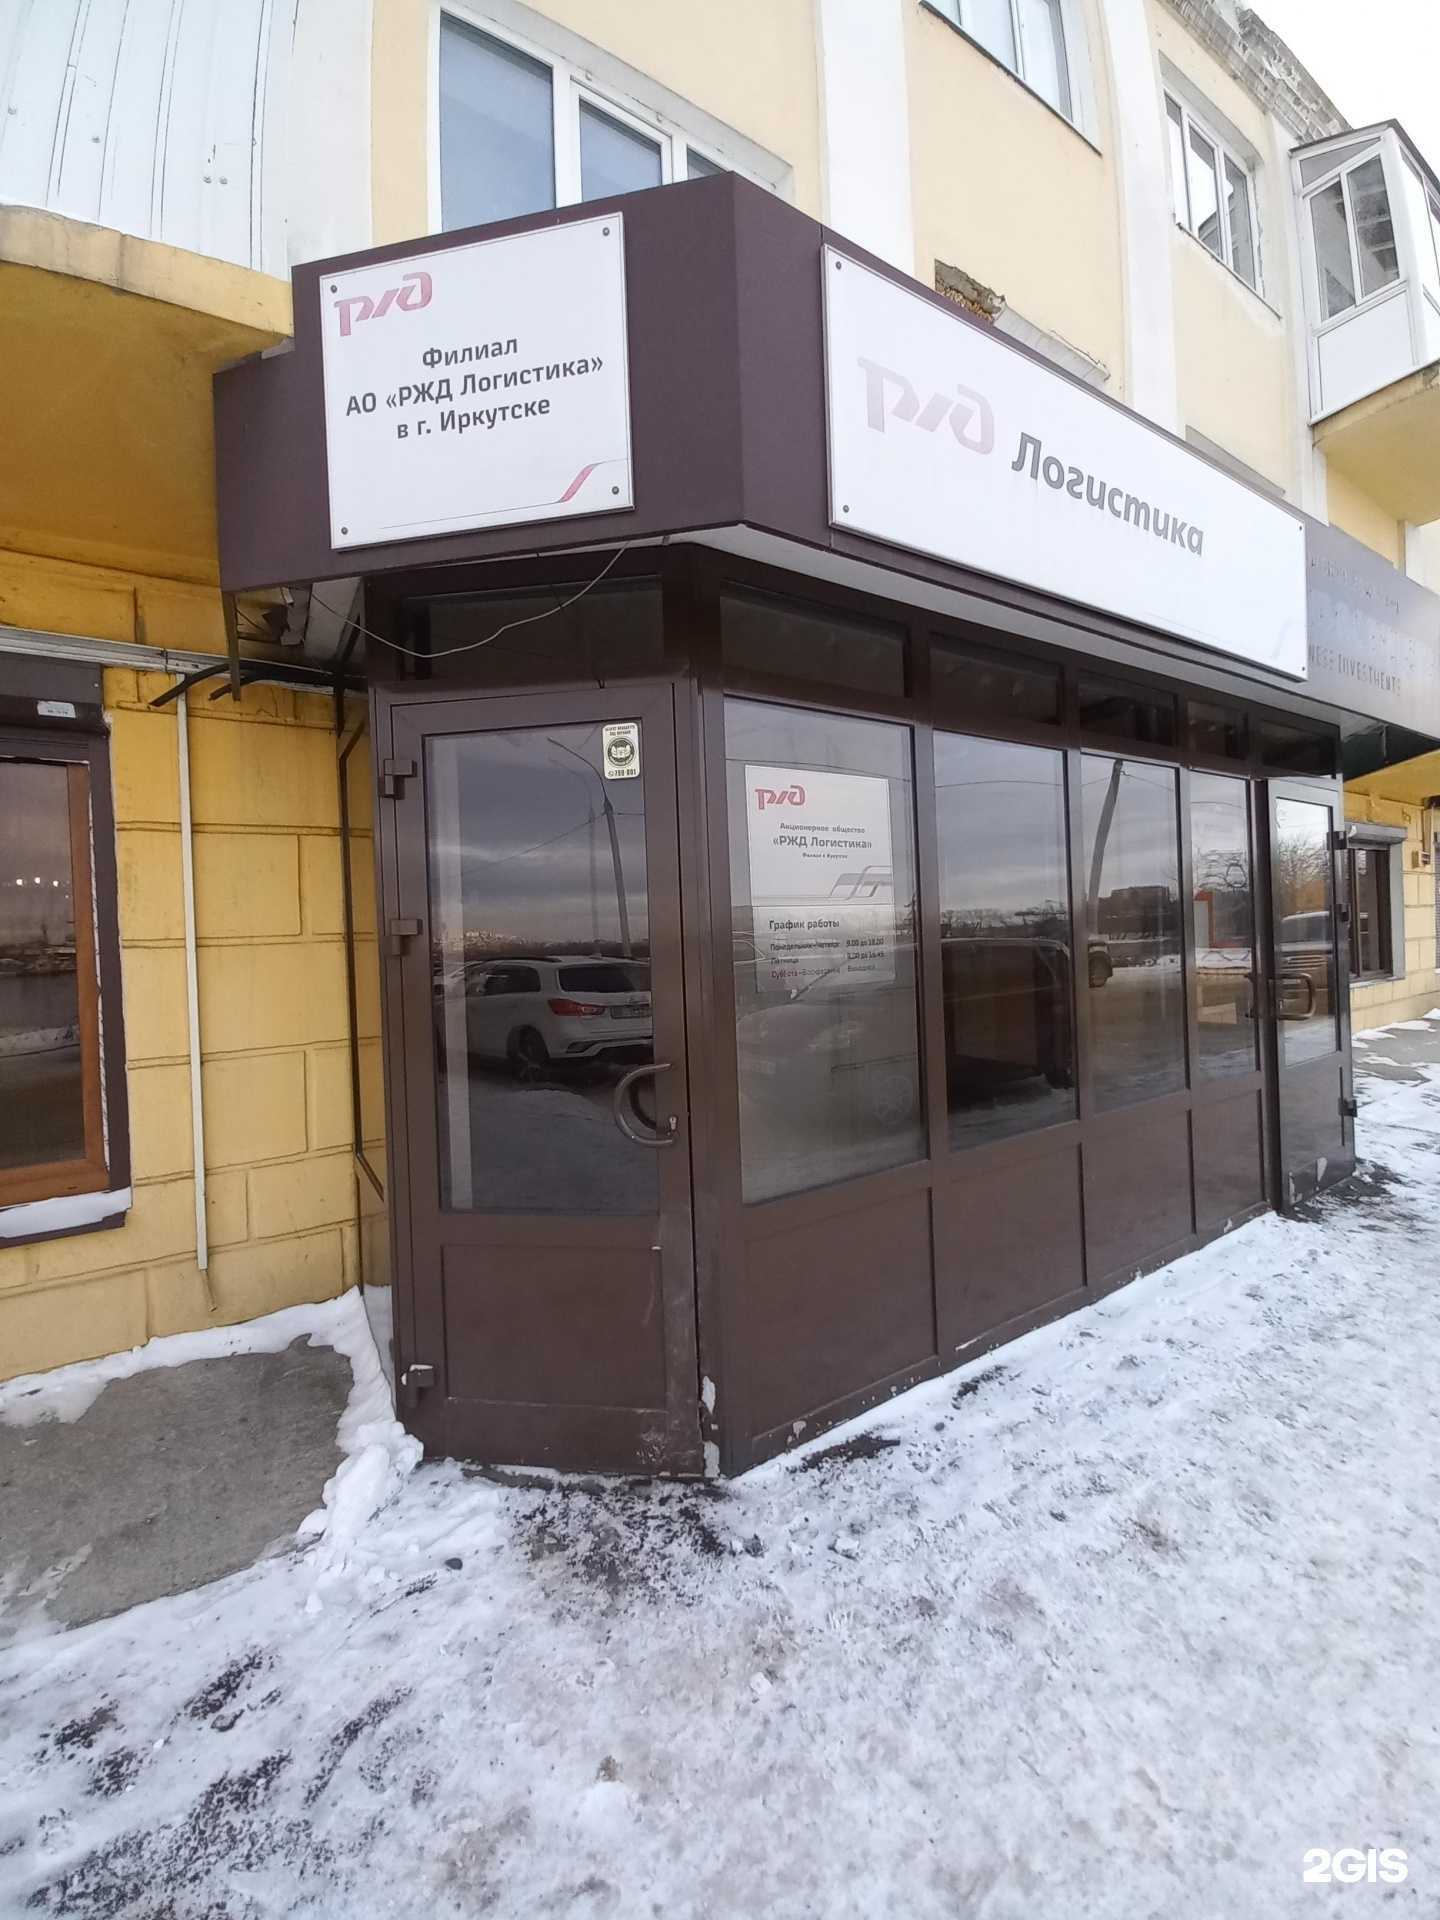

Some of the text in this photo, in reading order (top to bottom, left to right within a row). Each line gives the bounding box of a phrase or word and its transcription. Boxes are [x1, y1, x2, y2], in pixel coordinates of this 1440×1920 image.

[422, 338, 518, 368] Филиал
[346, 355, 604, 416] АО «РЖД Логистика»
[396, 398, 551, 439] в г. Иркутске
[1011, 431, 1204, 556] Логистика
[773, 835, 872, 849] «РЖД Логистика»
[769, 918, 840, 931] График работы
